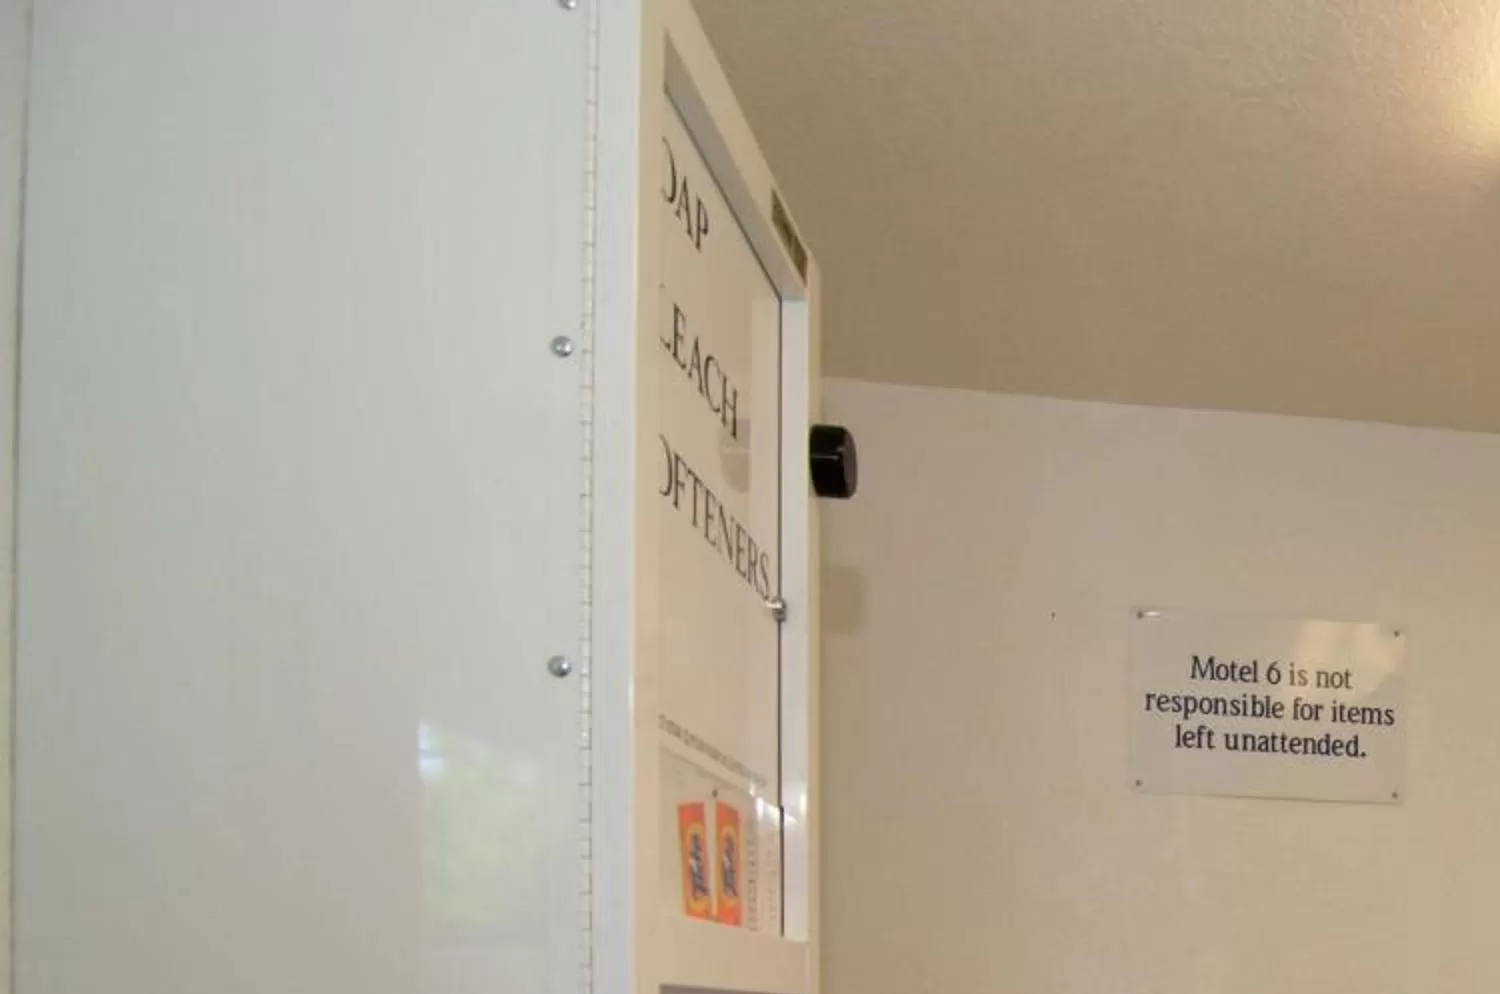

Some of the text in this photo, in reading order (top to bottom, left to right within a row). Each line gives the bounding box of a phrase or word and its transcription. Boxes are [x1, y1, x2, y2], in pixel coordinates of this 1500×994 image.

[660, 299, 739, 439] EACH
[1190, 655, 1353, 690] Motel 6 is not
[1145, 692, 1395, 727] responsible for items
[1175, 723, 1367, 758] left unattended.
